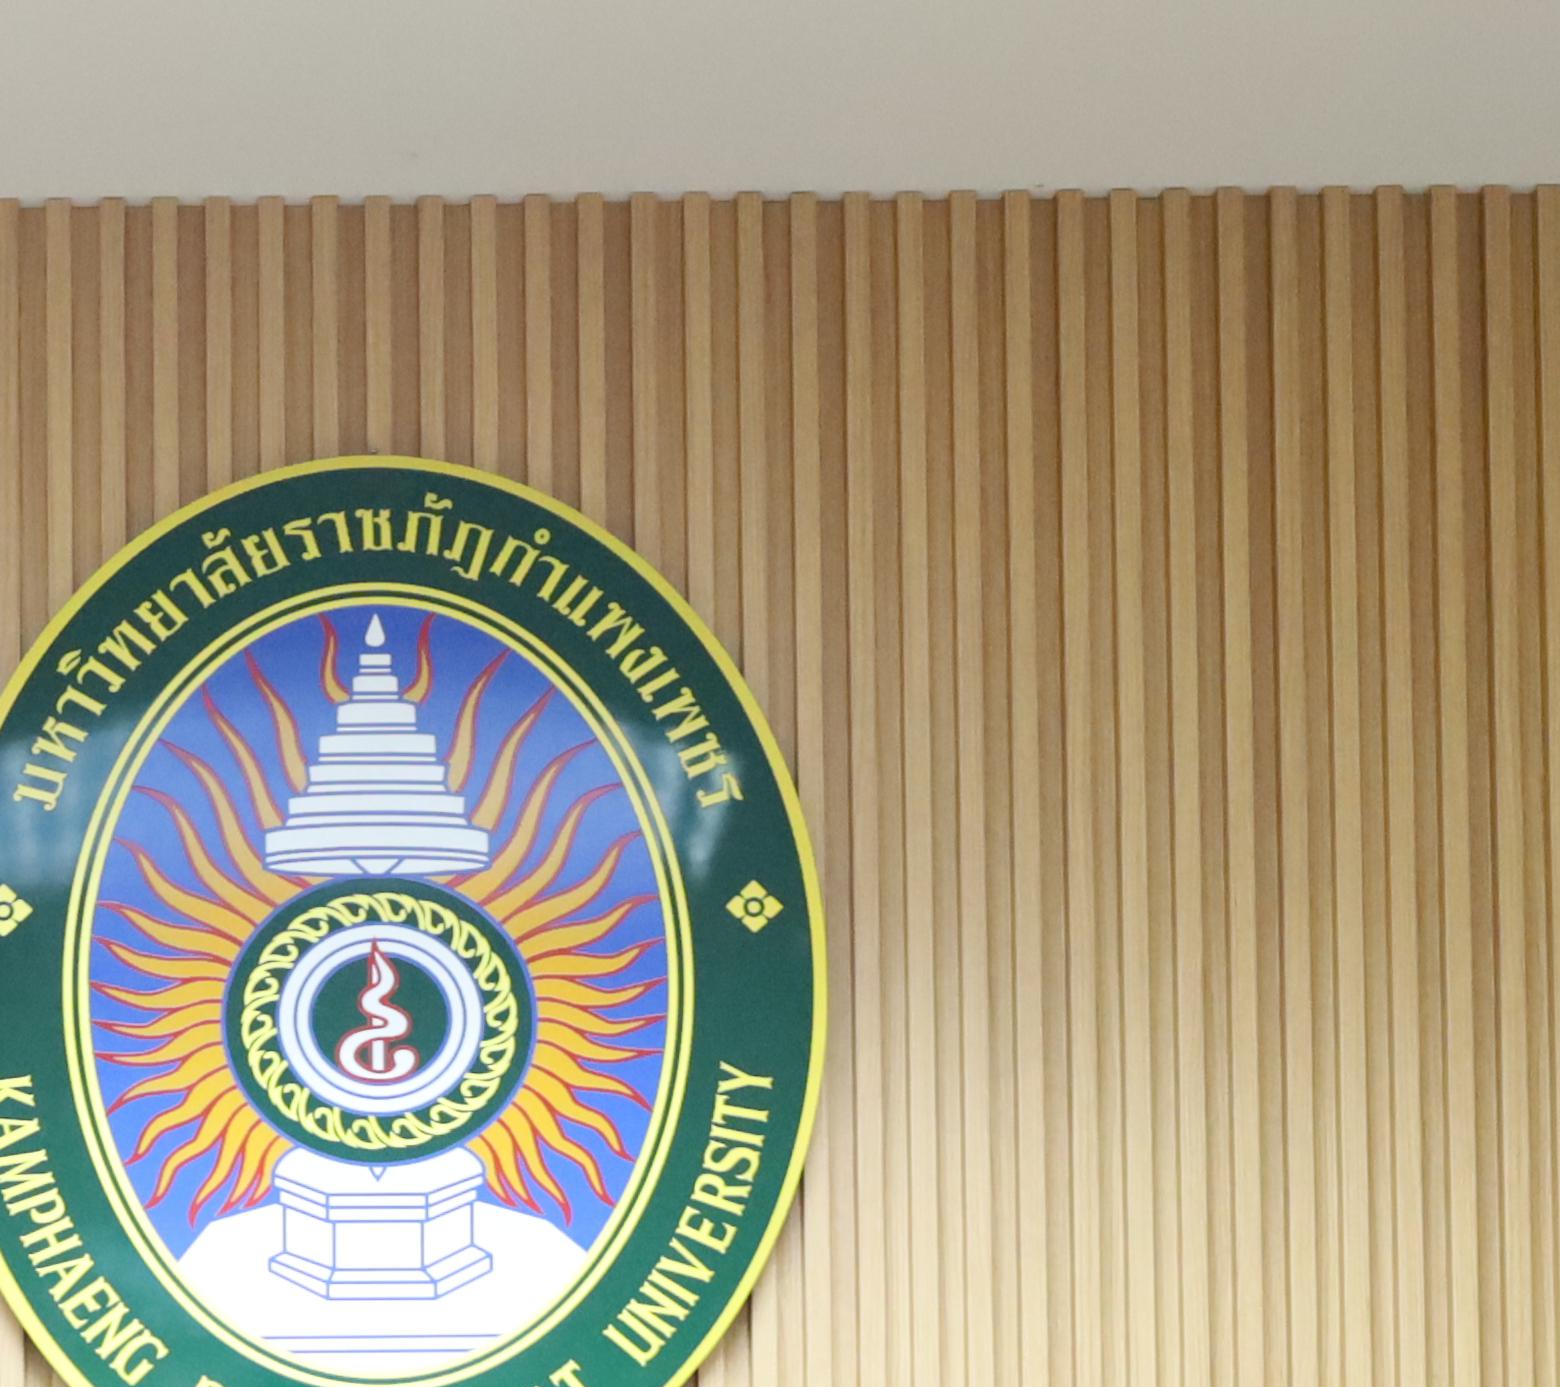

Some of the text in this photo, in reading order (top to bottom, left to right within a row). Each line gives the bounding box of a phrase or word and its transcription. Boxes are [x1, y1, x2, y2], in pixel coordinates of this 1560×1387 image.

[12, 491, 744, 811] มหาวิทยาลัยราชภัฏกำแพงเพชร
[600, 1059, 774, 1368] UNIVERSITY
